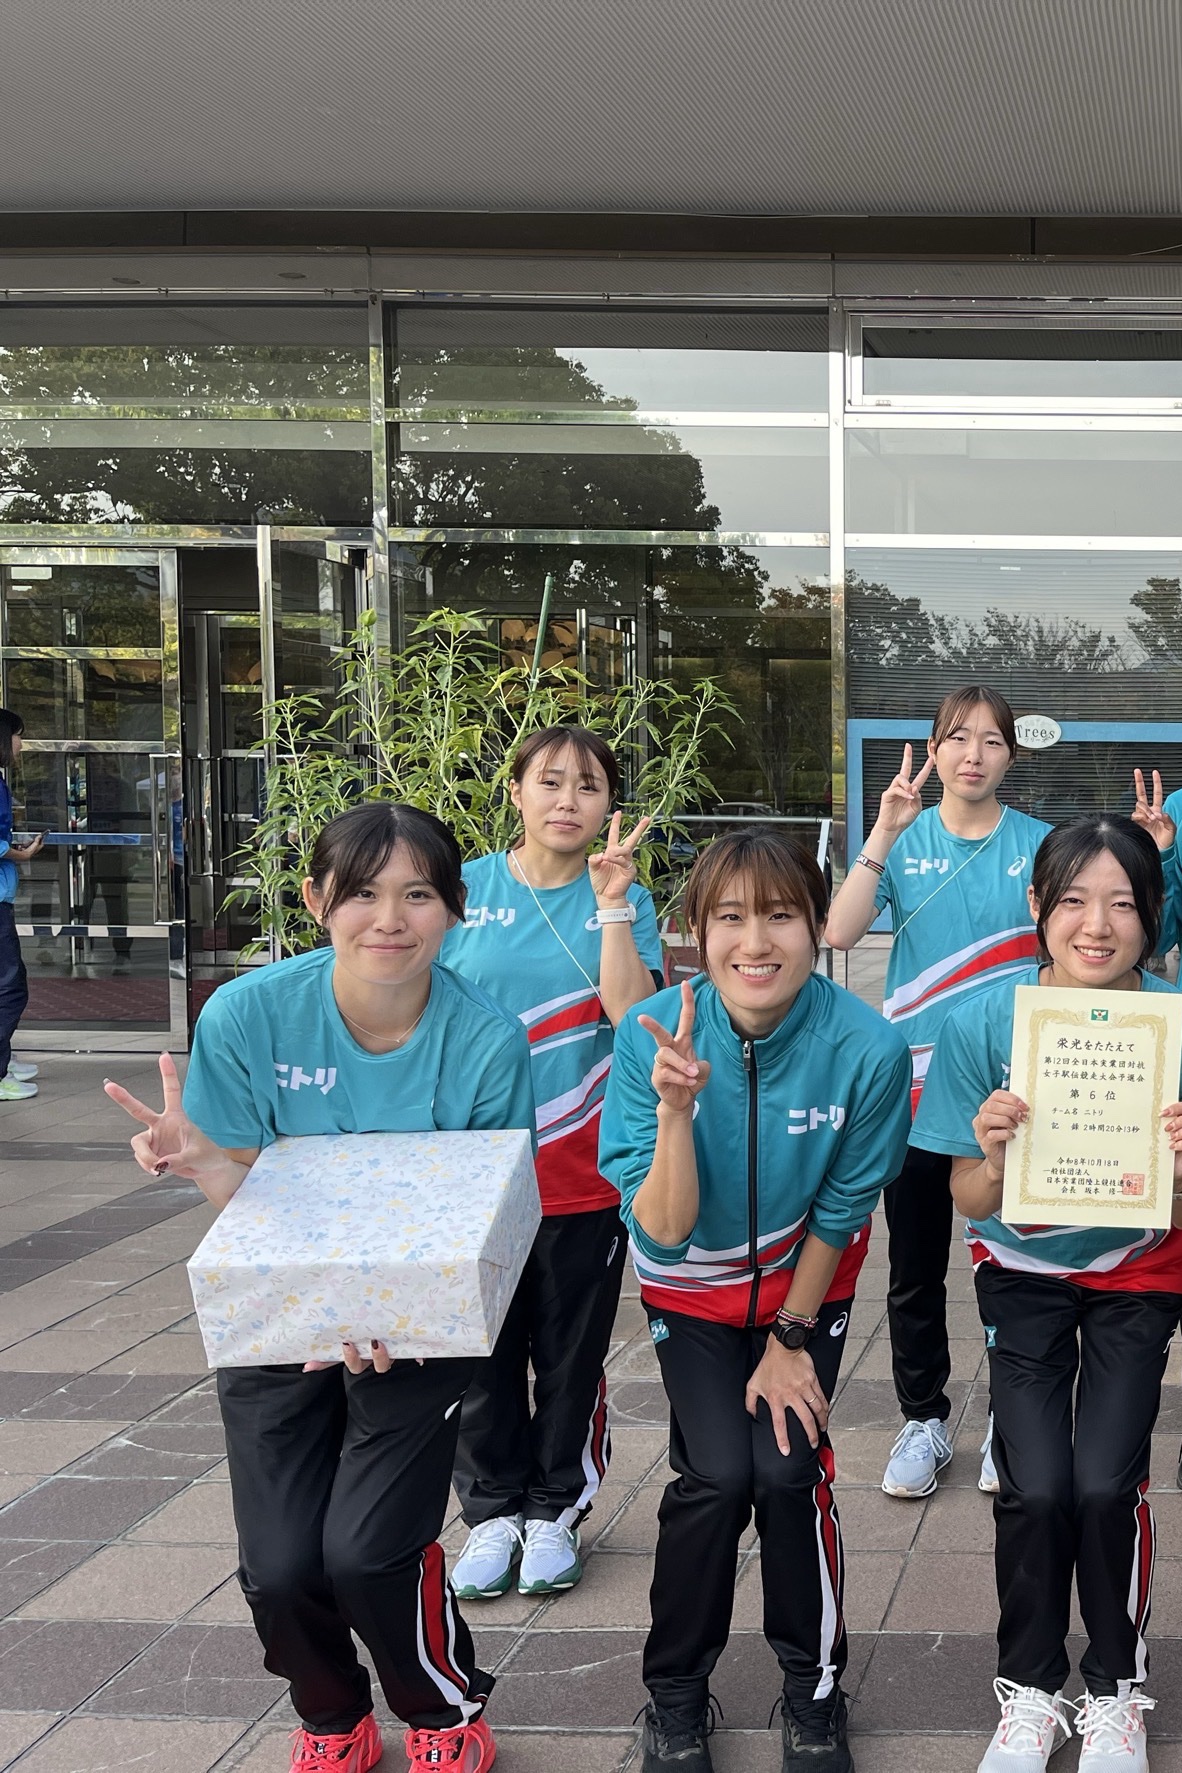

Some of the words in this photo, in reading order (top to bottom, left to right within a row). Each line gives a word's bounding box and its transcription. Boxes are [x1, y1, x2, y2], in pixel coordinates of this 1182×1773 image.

[1015, 724, 1055, 740] Trees
[904, 858, 949, 875] ニトリ
[463, 906, 516, 929] ニトリ
[1057, 1037, 1135, 1052] 栄光をたたえて
[1044, 1056, 1146, 1070] 第12回全日本実業団対抗
[274, 1063, 337, 1096] ニトリ
[1043, 1069, 1146, 1082] 女子駅伝競走大会予選会
[1052, 1107, 1078, 1115] チーム名
[788, 1105, 846, 1135] ニトリ
[1083, 1124, 1140, 1133] 2時間20分13秒
[1043, 1167, 1090, 1176] 一般社団法人
[1046, 1176, 1133, 1187] 日本実業団陸上競技連合
